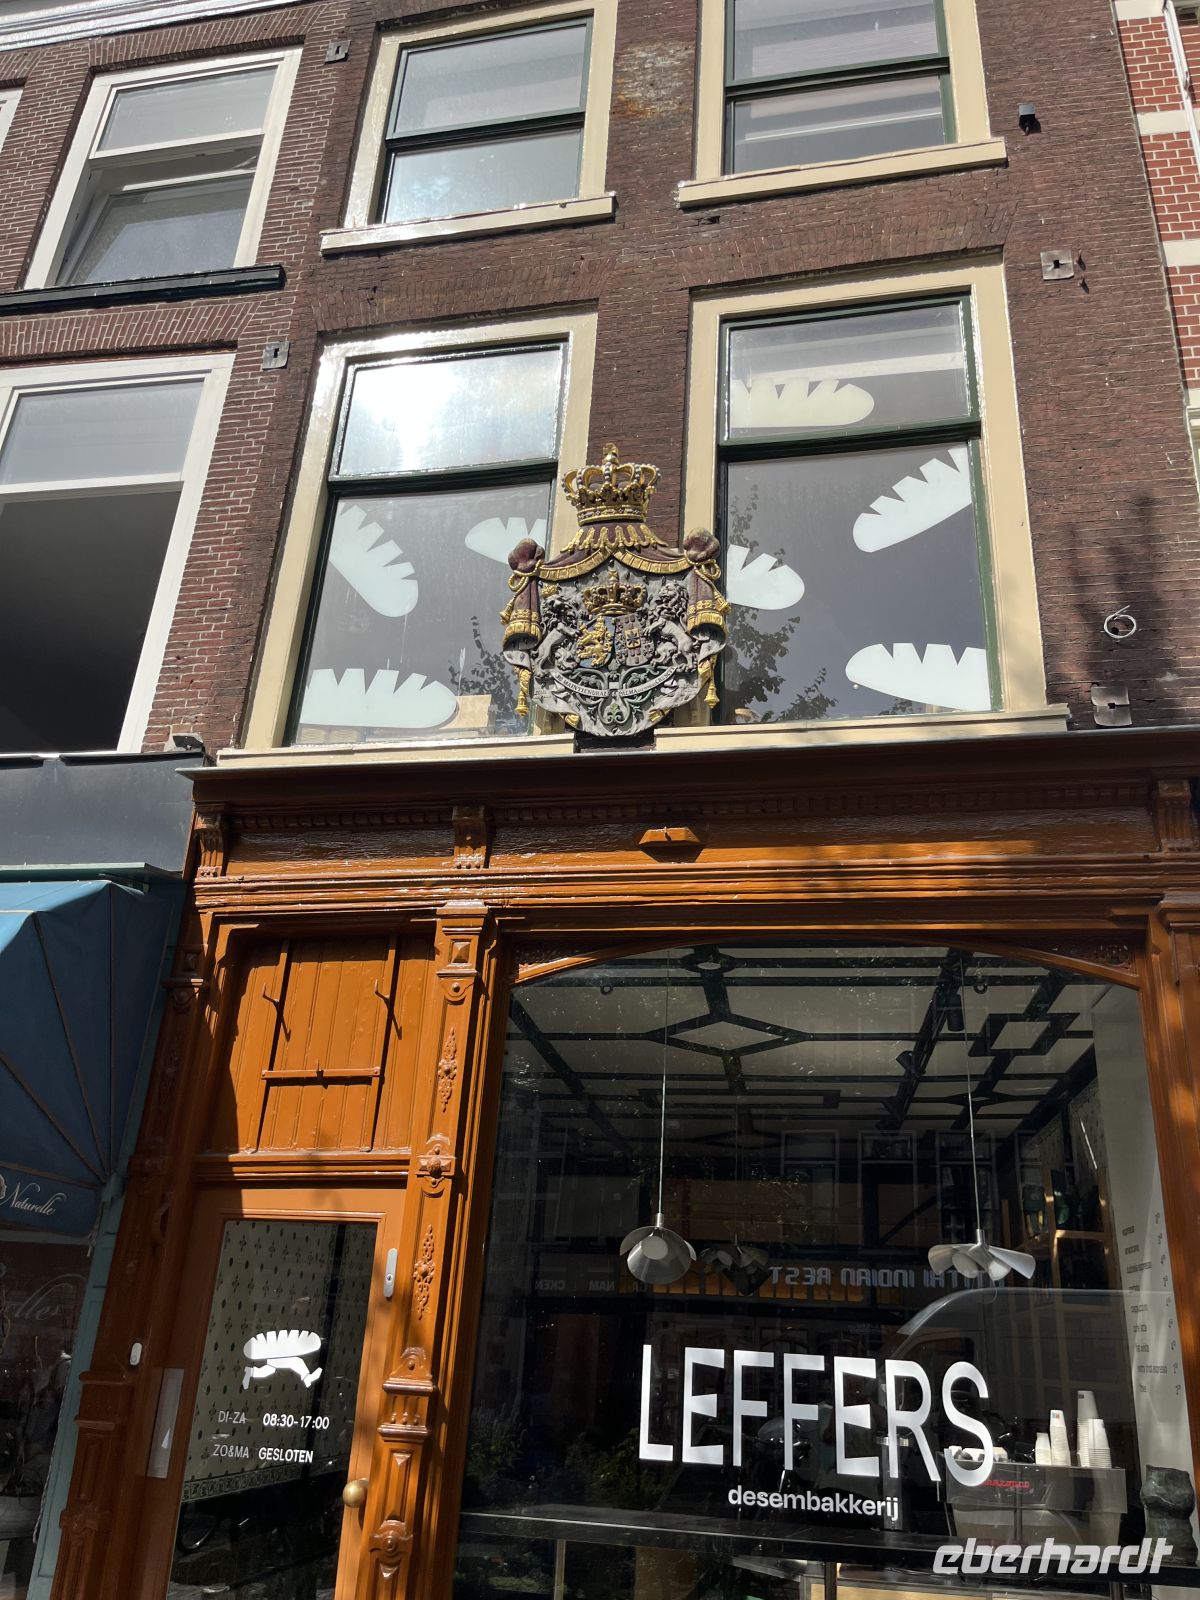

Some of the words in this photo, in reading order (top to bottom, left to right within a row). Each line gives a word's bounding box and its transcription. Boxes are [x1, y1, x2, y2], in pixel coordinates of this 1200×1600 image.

[1, 1182, 66, 1215] Naturelle
[218, 1411, 246, 1424] DI-ZA
[262, 1413, 330, 1430] 08:30-17:00
[639, 1344, 993, 1487] LEFFERS
[213, 1444, 249, 1458] ZO&MA
[258, 1447, 314, 1463] GESLOTEN
[728, 1485, 899, 1521] desembakkerij
